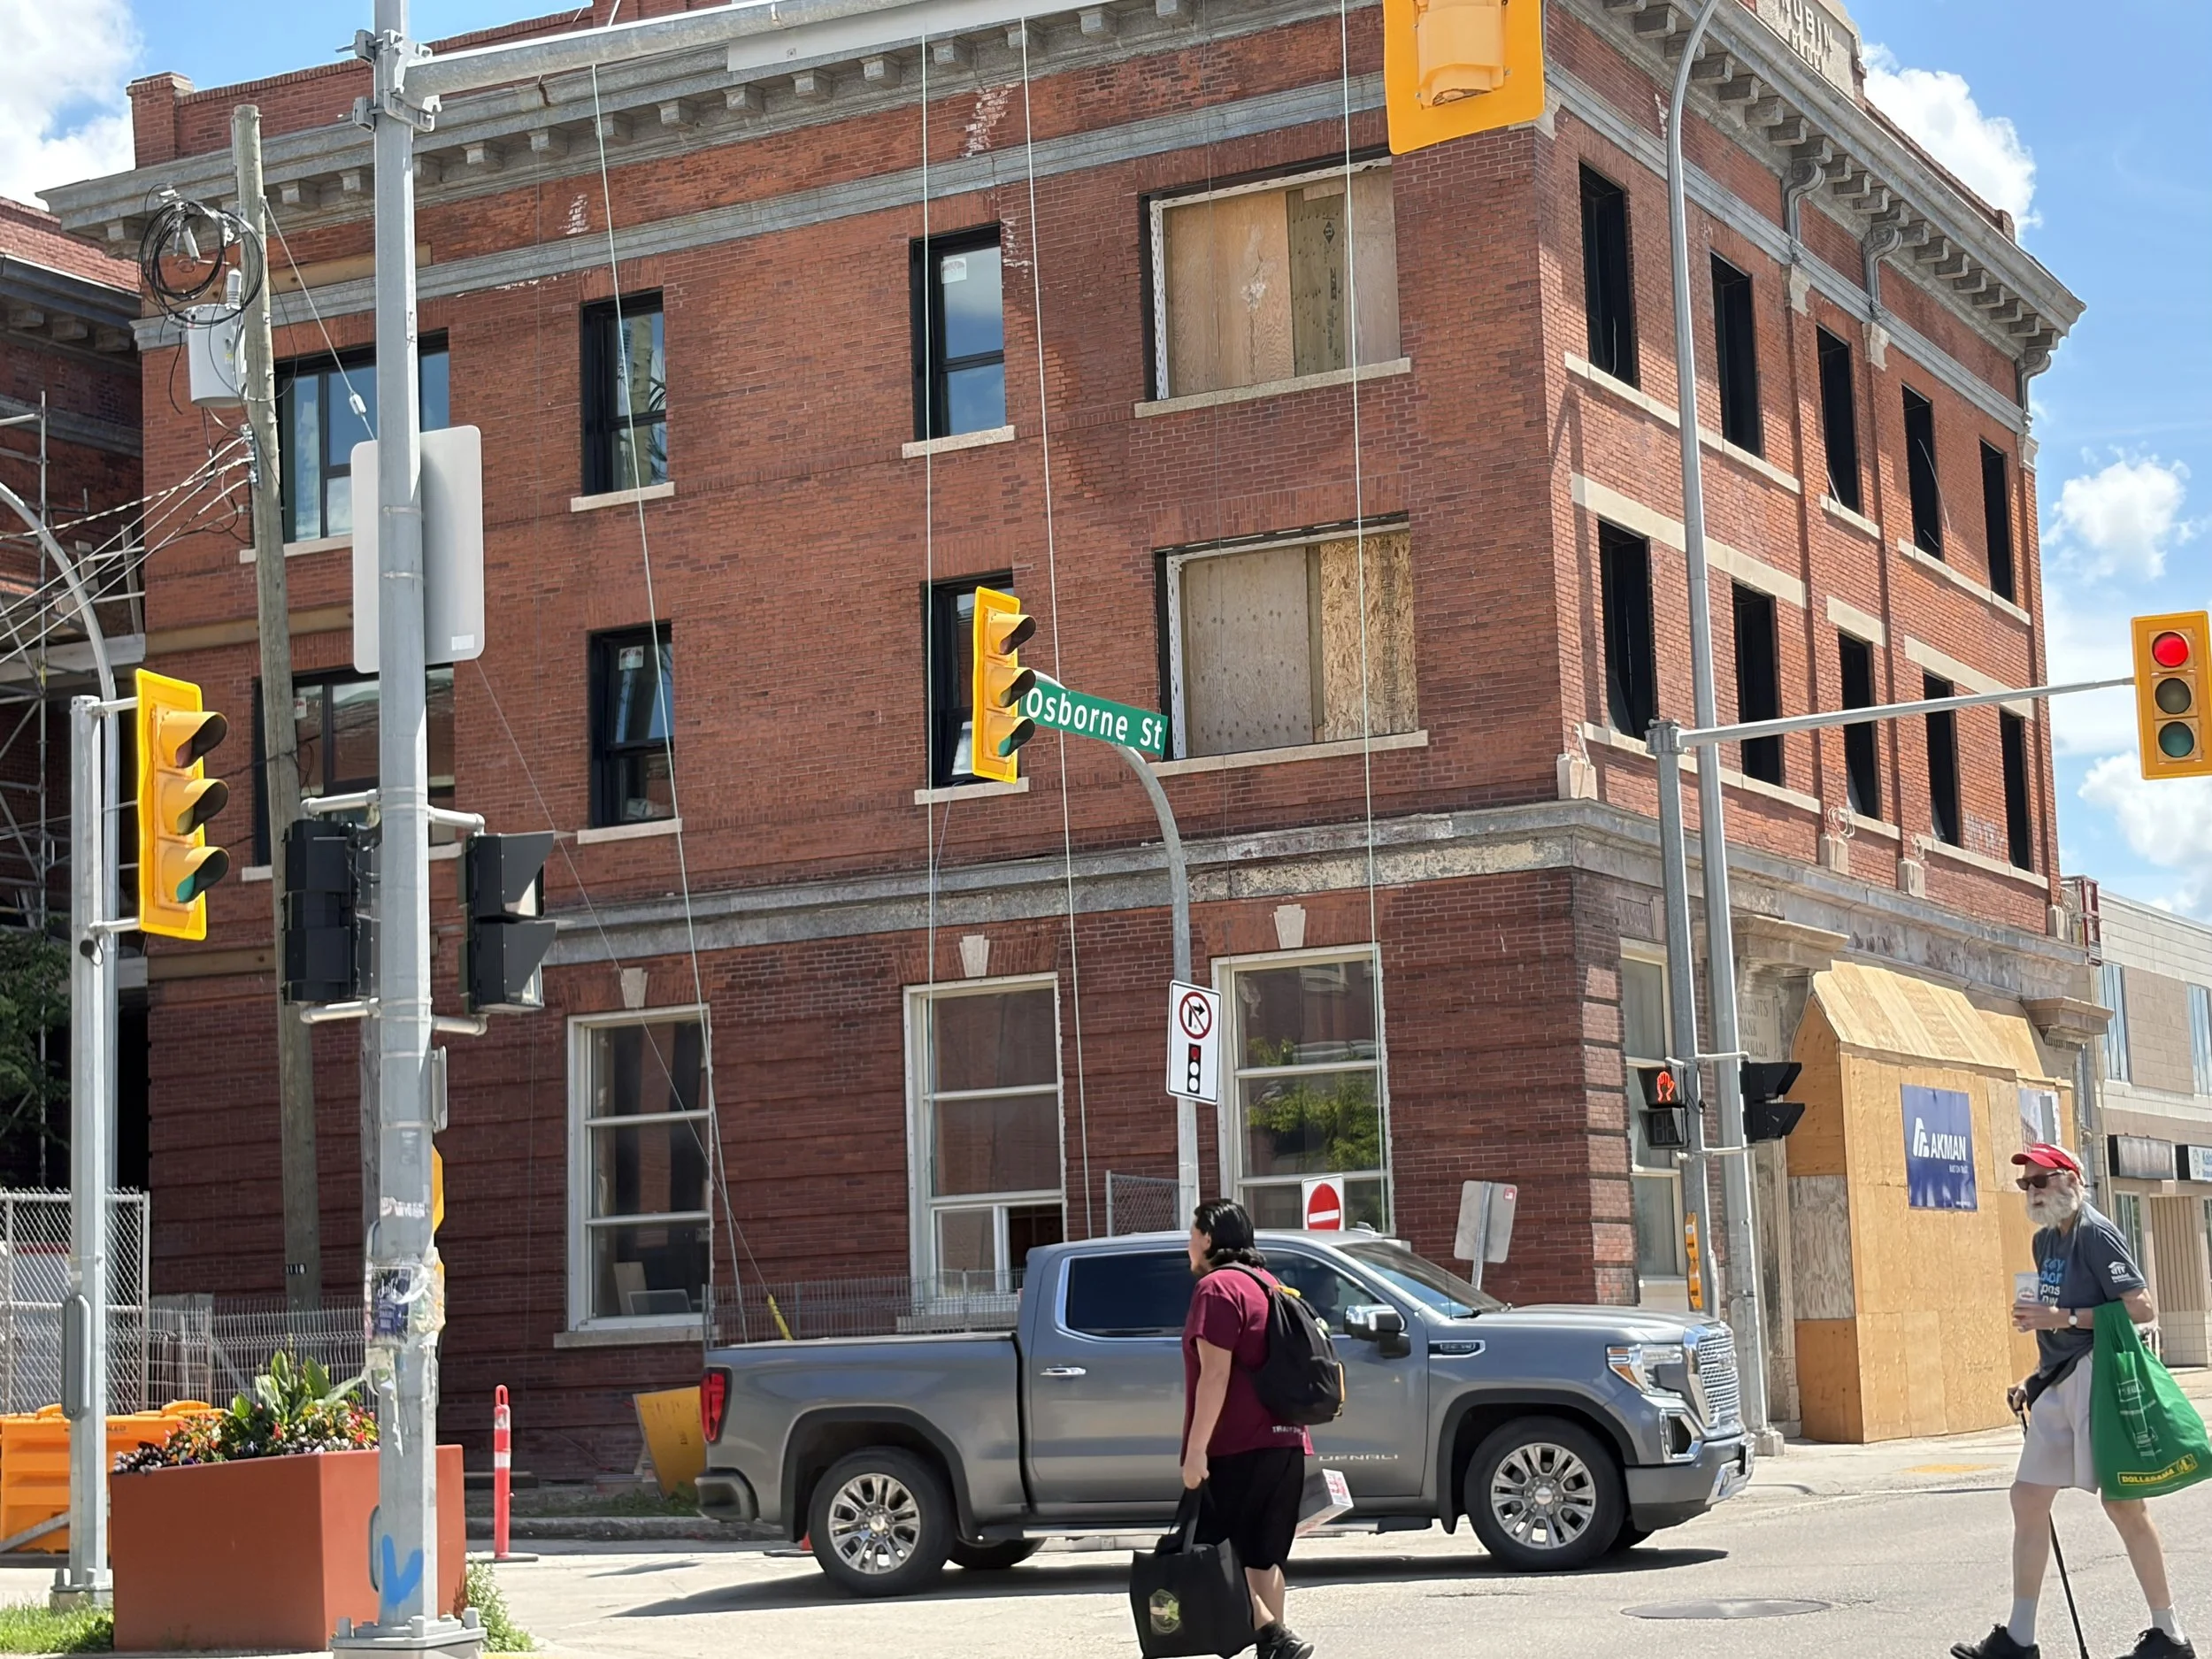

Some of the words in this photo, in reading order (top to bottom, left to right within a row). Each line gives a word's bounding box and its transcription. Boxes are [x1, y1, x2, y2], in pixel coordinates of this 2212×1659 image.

[1026, 687, 1128, 741] Osborne
[1140, 718, 1163, 749] St
[1930, 1133, 1967, 1161] AKMAN
